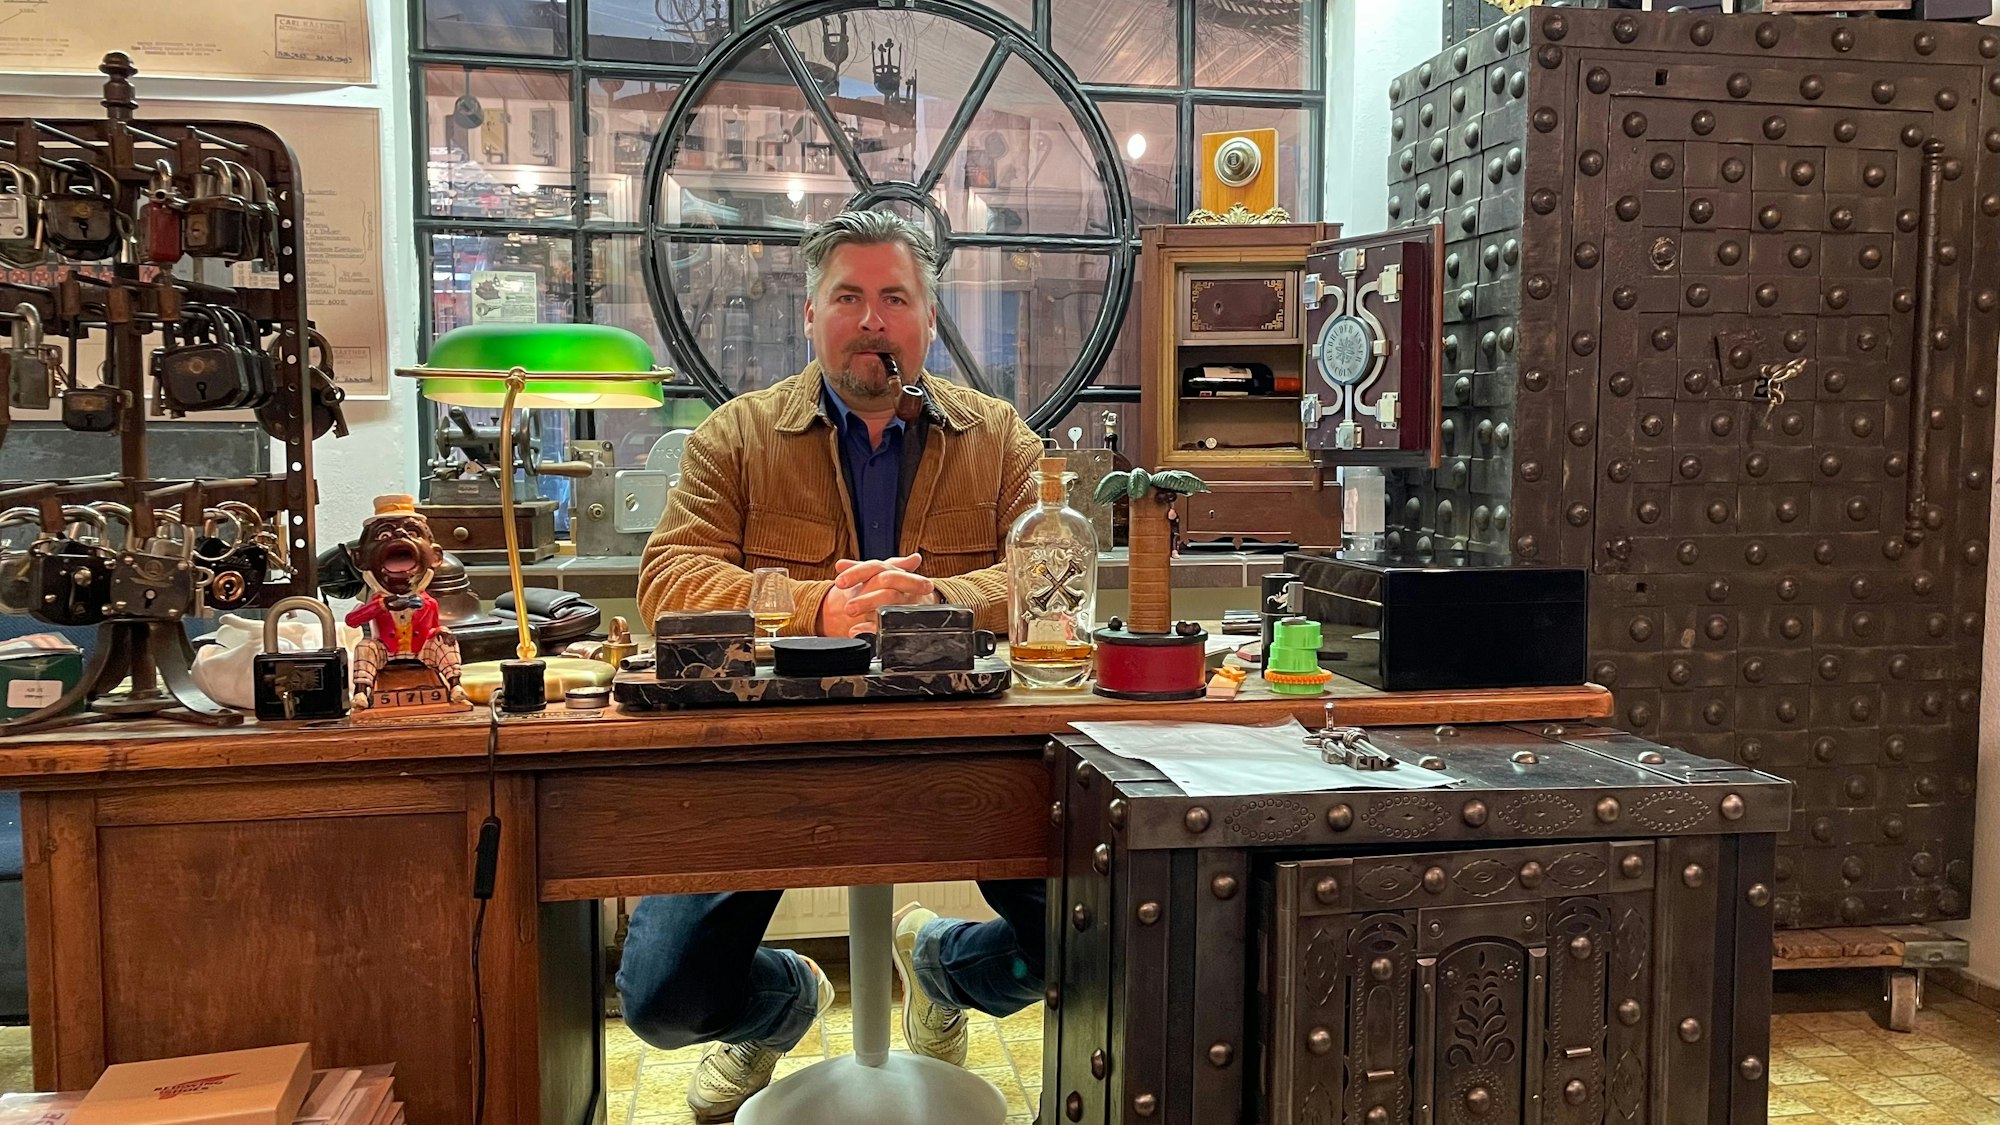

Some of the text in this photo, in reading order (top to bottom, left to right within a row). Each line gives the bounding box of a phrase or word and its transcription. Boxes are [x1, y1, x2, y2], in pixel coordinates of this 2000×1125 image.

[381, 690, 441, 704] 5 7 9
